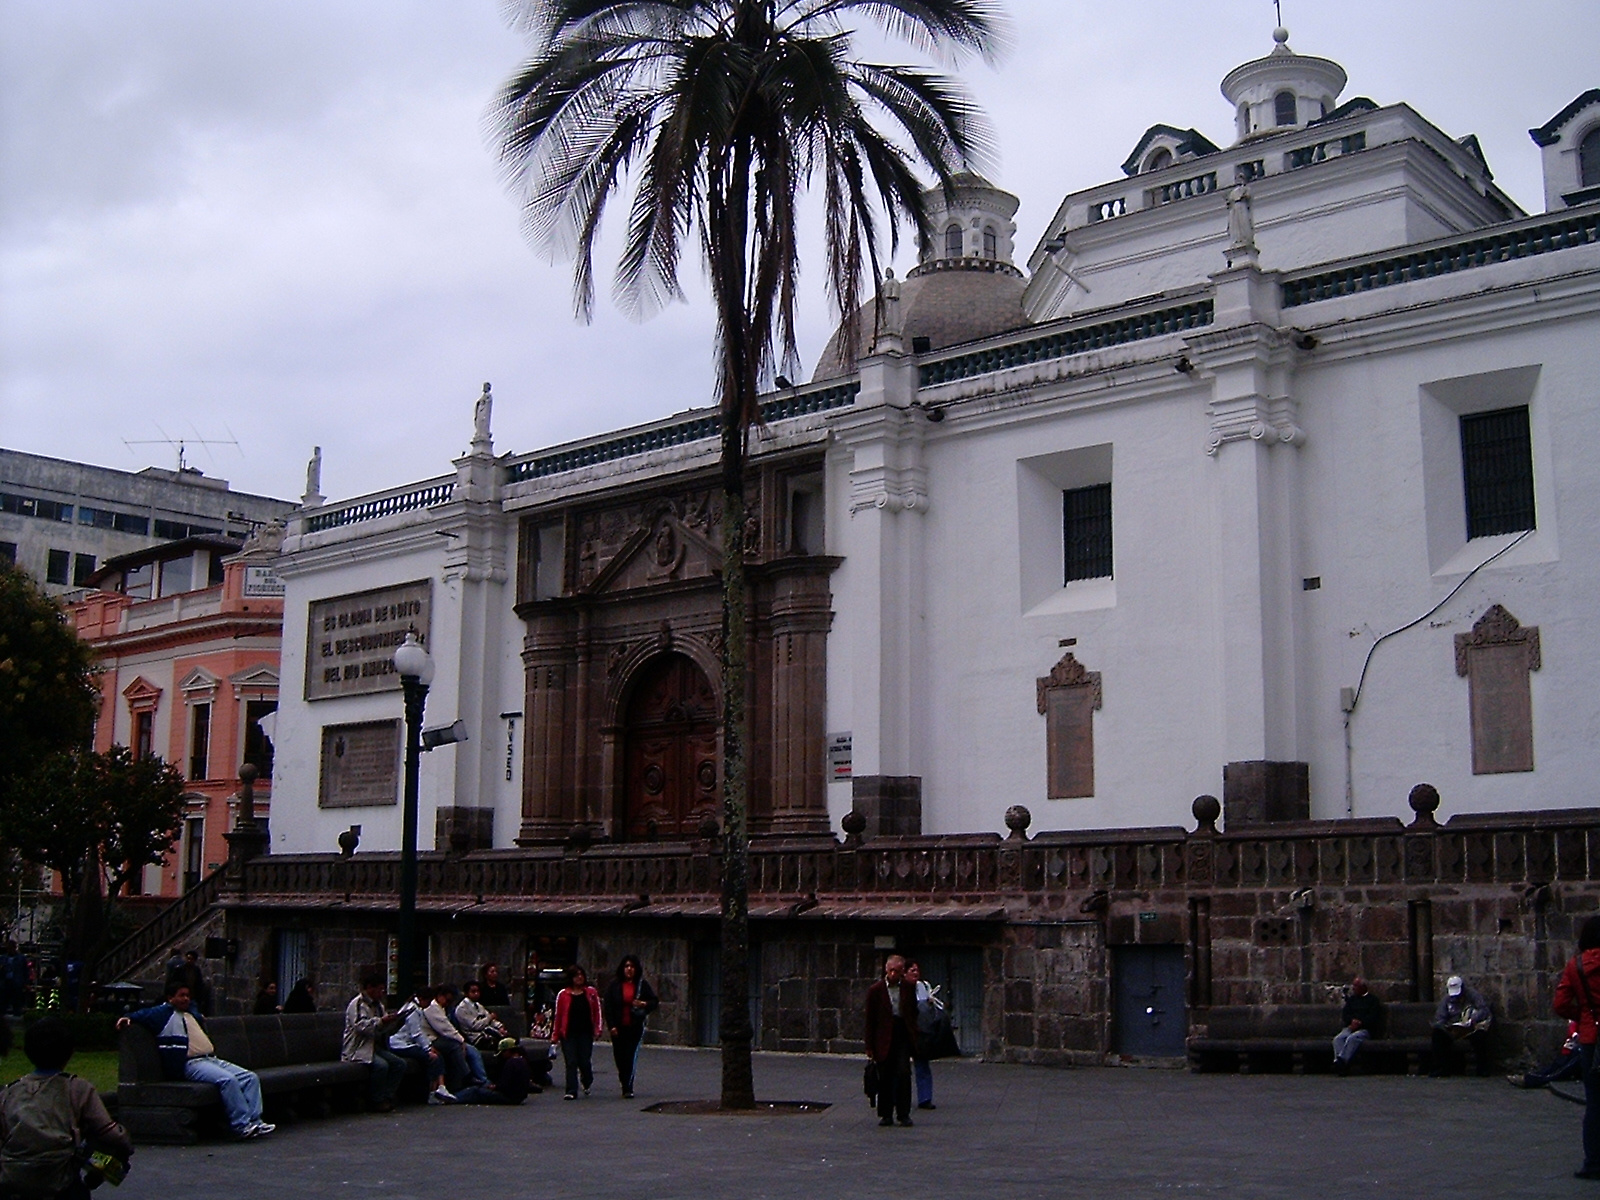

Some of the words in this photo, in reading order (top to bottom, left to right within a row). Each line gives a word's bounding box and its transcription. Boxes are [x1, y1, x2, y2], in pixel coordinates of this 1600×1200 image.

[338, 608, 372, 629] GLORIA
[375, 605, 388, 622] DE
[390, 600, 421, 620] QUITO
[321, 642, 334, 657] EL
[324, 667, 341, 683] DEL
[362, 658, 398, 678] AMAZO
[506, 719, 515, 781] MUSEO
